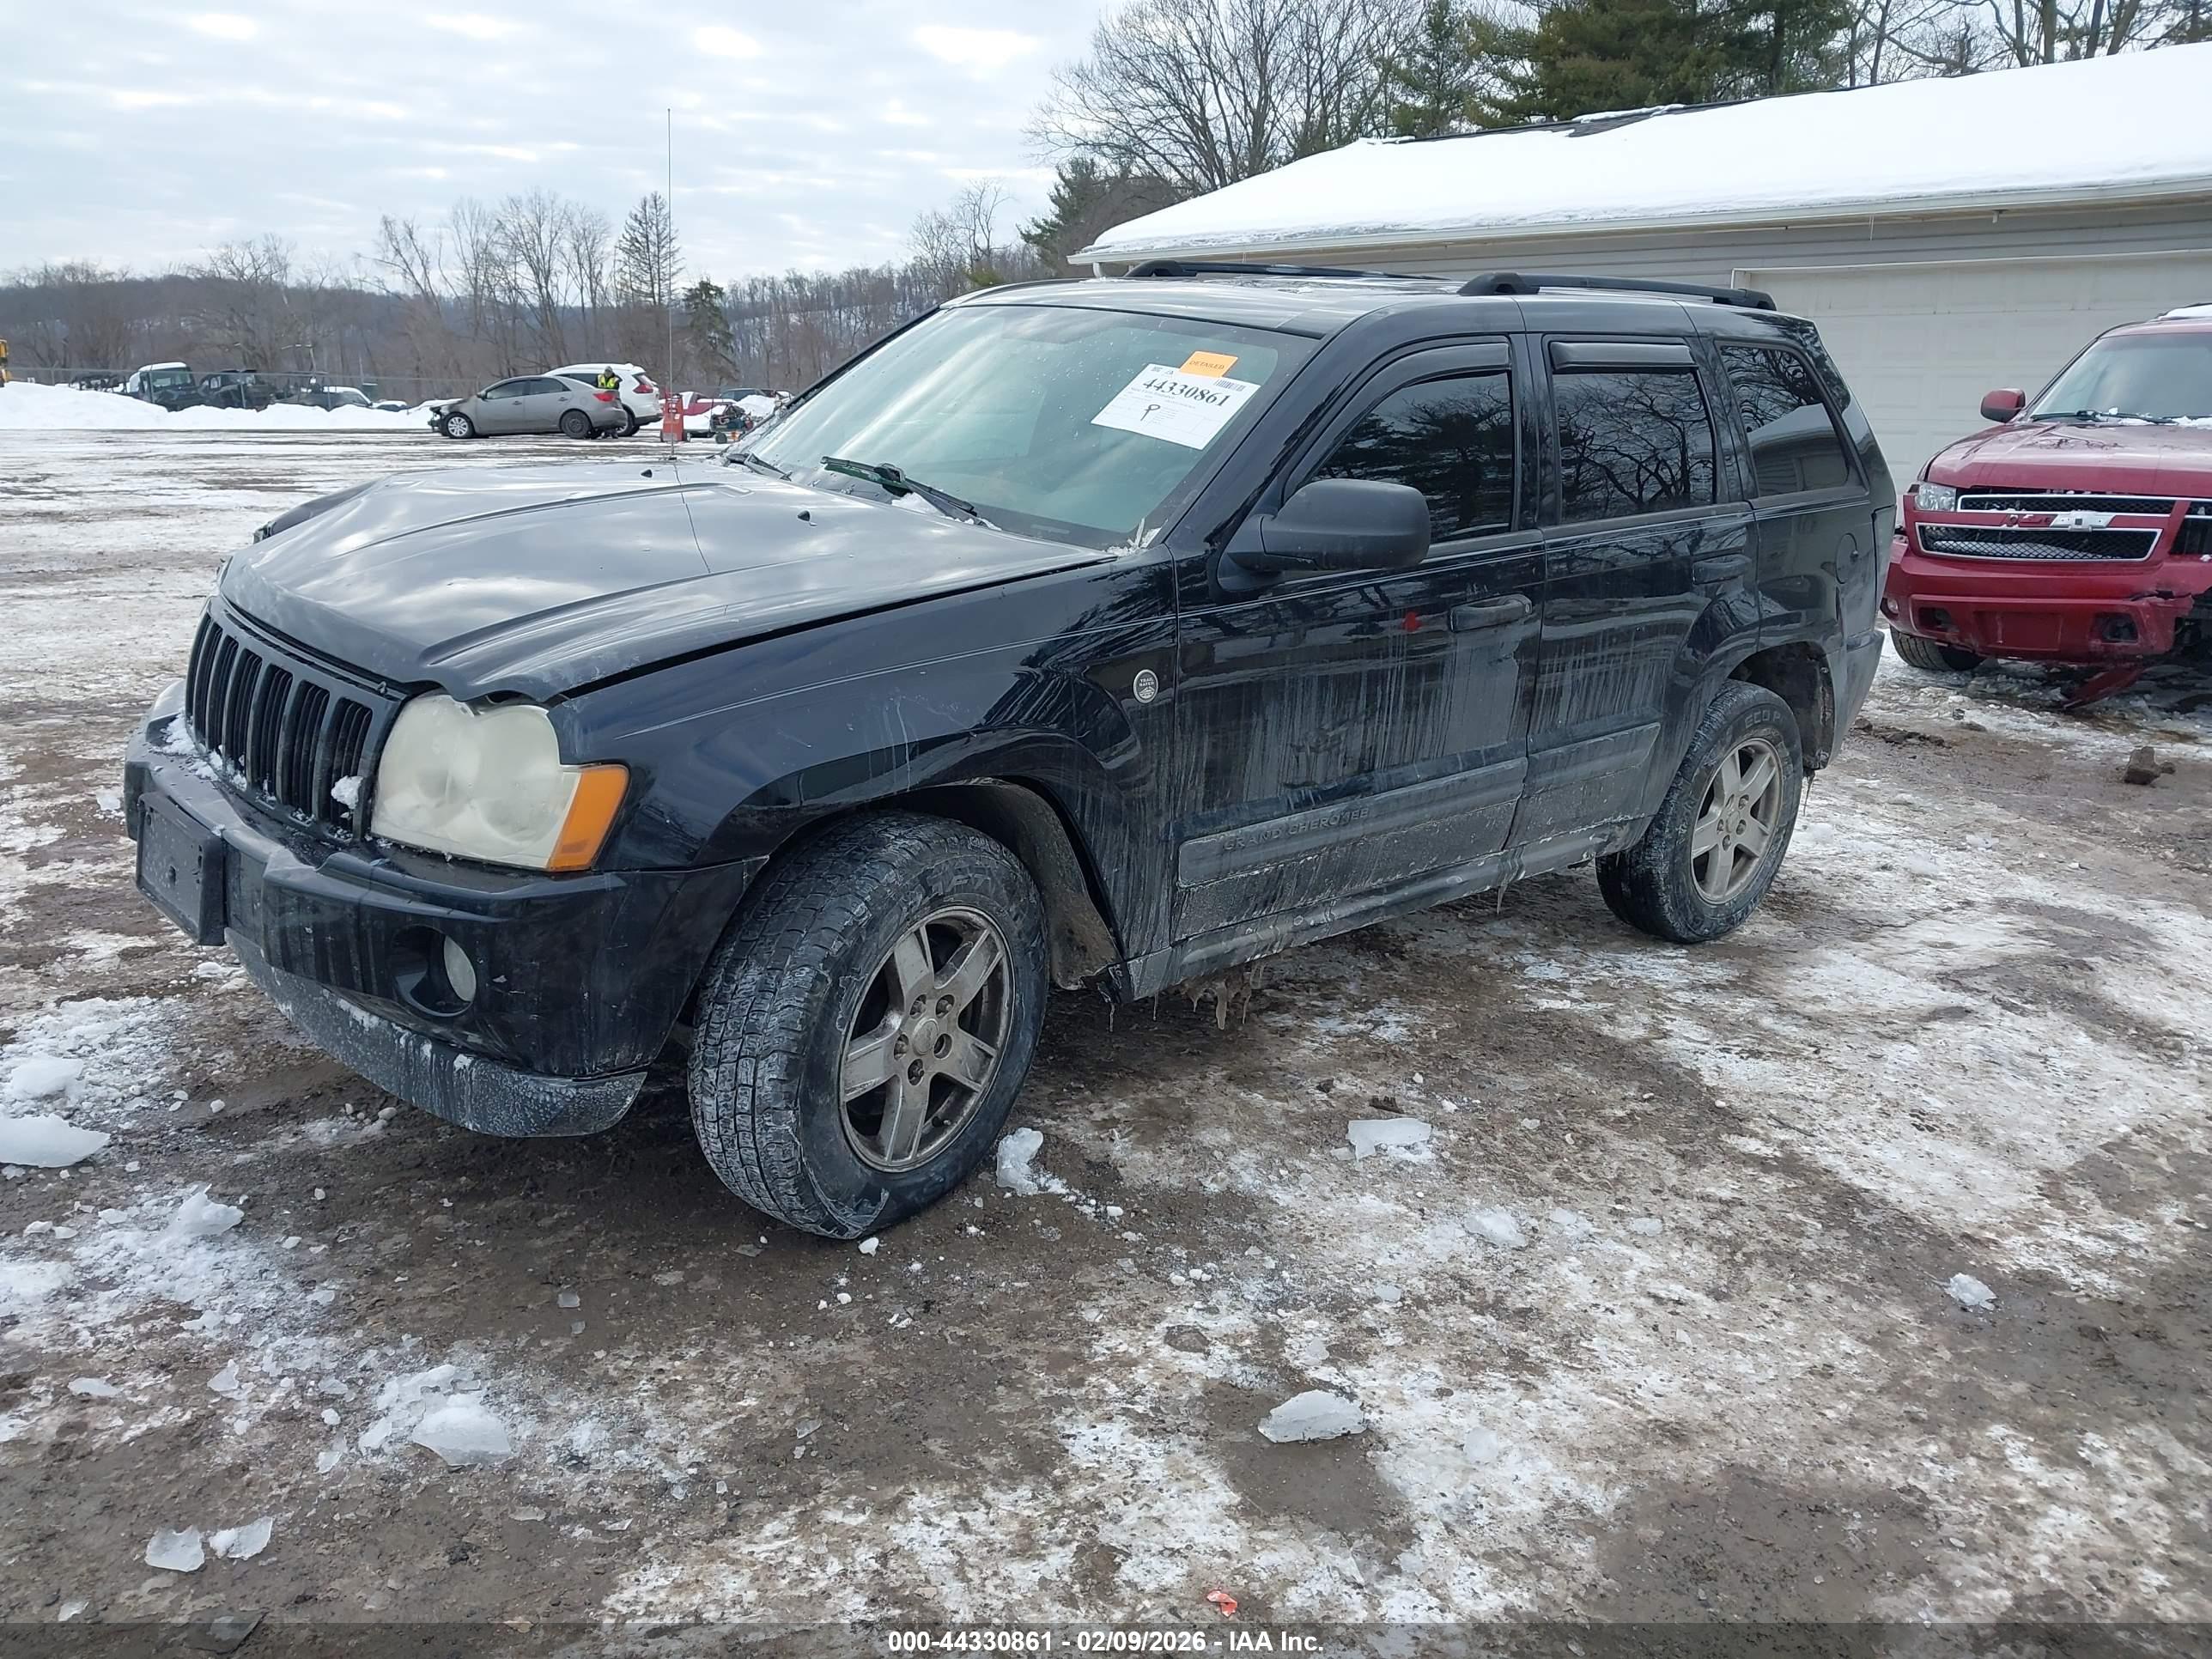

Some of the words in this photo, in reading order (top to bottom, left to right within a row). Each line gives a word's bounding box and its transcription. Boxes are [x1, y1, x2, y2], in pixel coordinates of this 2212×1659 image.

[1188, 360, 1226, 370] DETAILED
[1143, 378, 1231, 407] 44330861
[1223, 828, 1283, 851] GRAND
